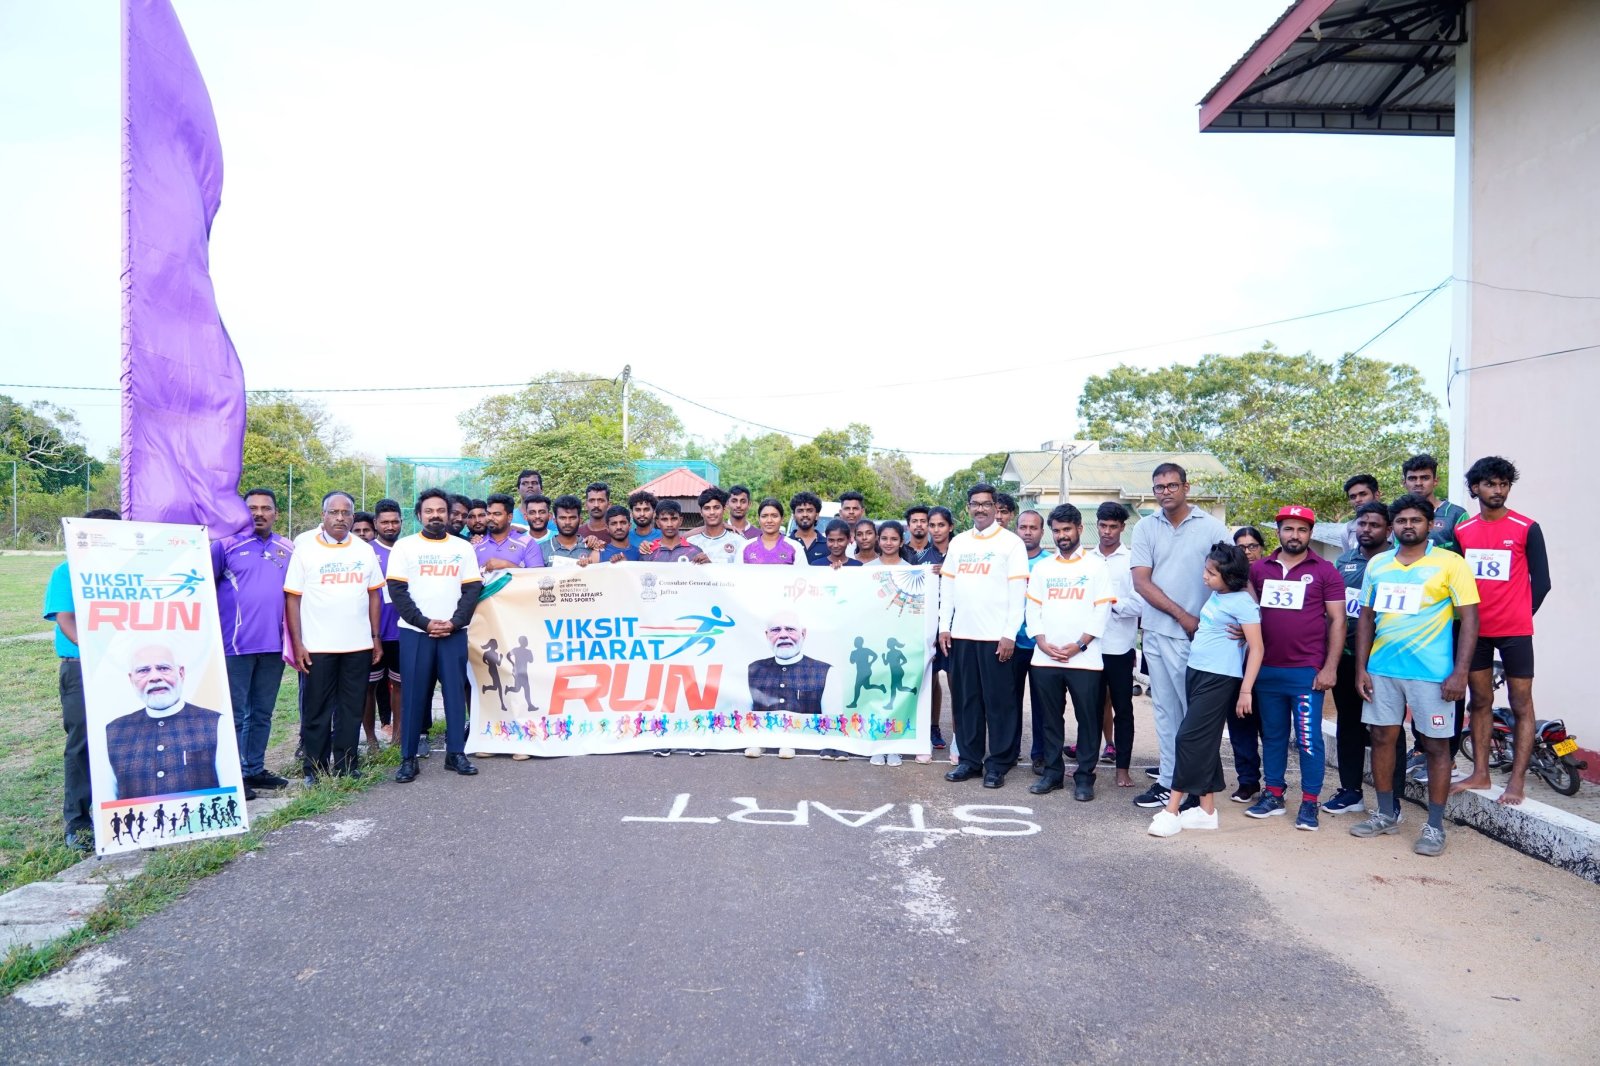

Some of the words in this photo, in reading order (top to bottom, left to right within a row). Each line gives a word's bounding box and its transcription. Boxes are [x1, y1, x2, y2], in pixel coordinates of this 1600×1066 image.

[1290, 507, 1301, 516] K
[420, 564, 460, 577] RUN
[957, 562, 991, 575] RUN
[1475, 560, 1501, 578] 18
[80, 572, 144, 587] VIKSIT
[321, 572, 363, 584] RUN
[81, 586, 163, 600] BHARAT
[1048, 587, 1086, 600] RUN
[1267, 591, 1294, 607] 33
[1346, 598, 1361, 614] 0
[1382, 594, 1406, 611] 11
[87, 600, 202, 632] RUN
[544, 617, 639, 640] VIKSIT
[546, 639, 665, 663] BHARAT
[548, 663, 724, 716] RUN
[1297, 694, 1315, 758] TOMMY
[620, 793, 1042, 837] START
